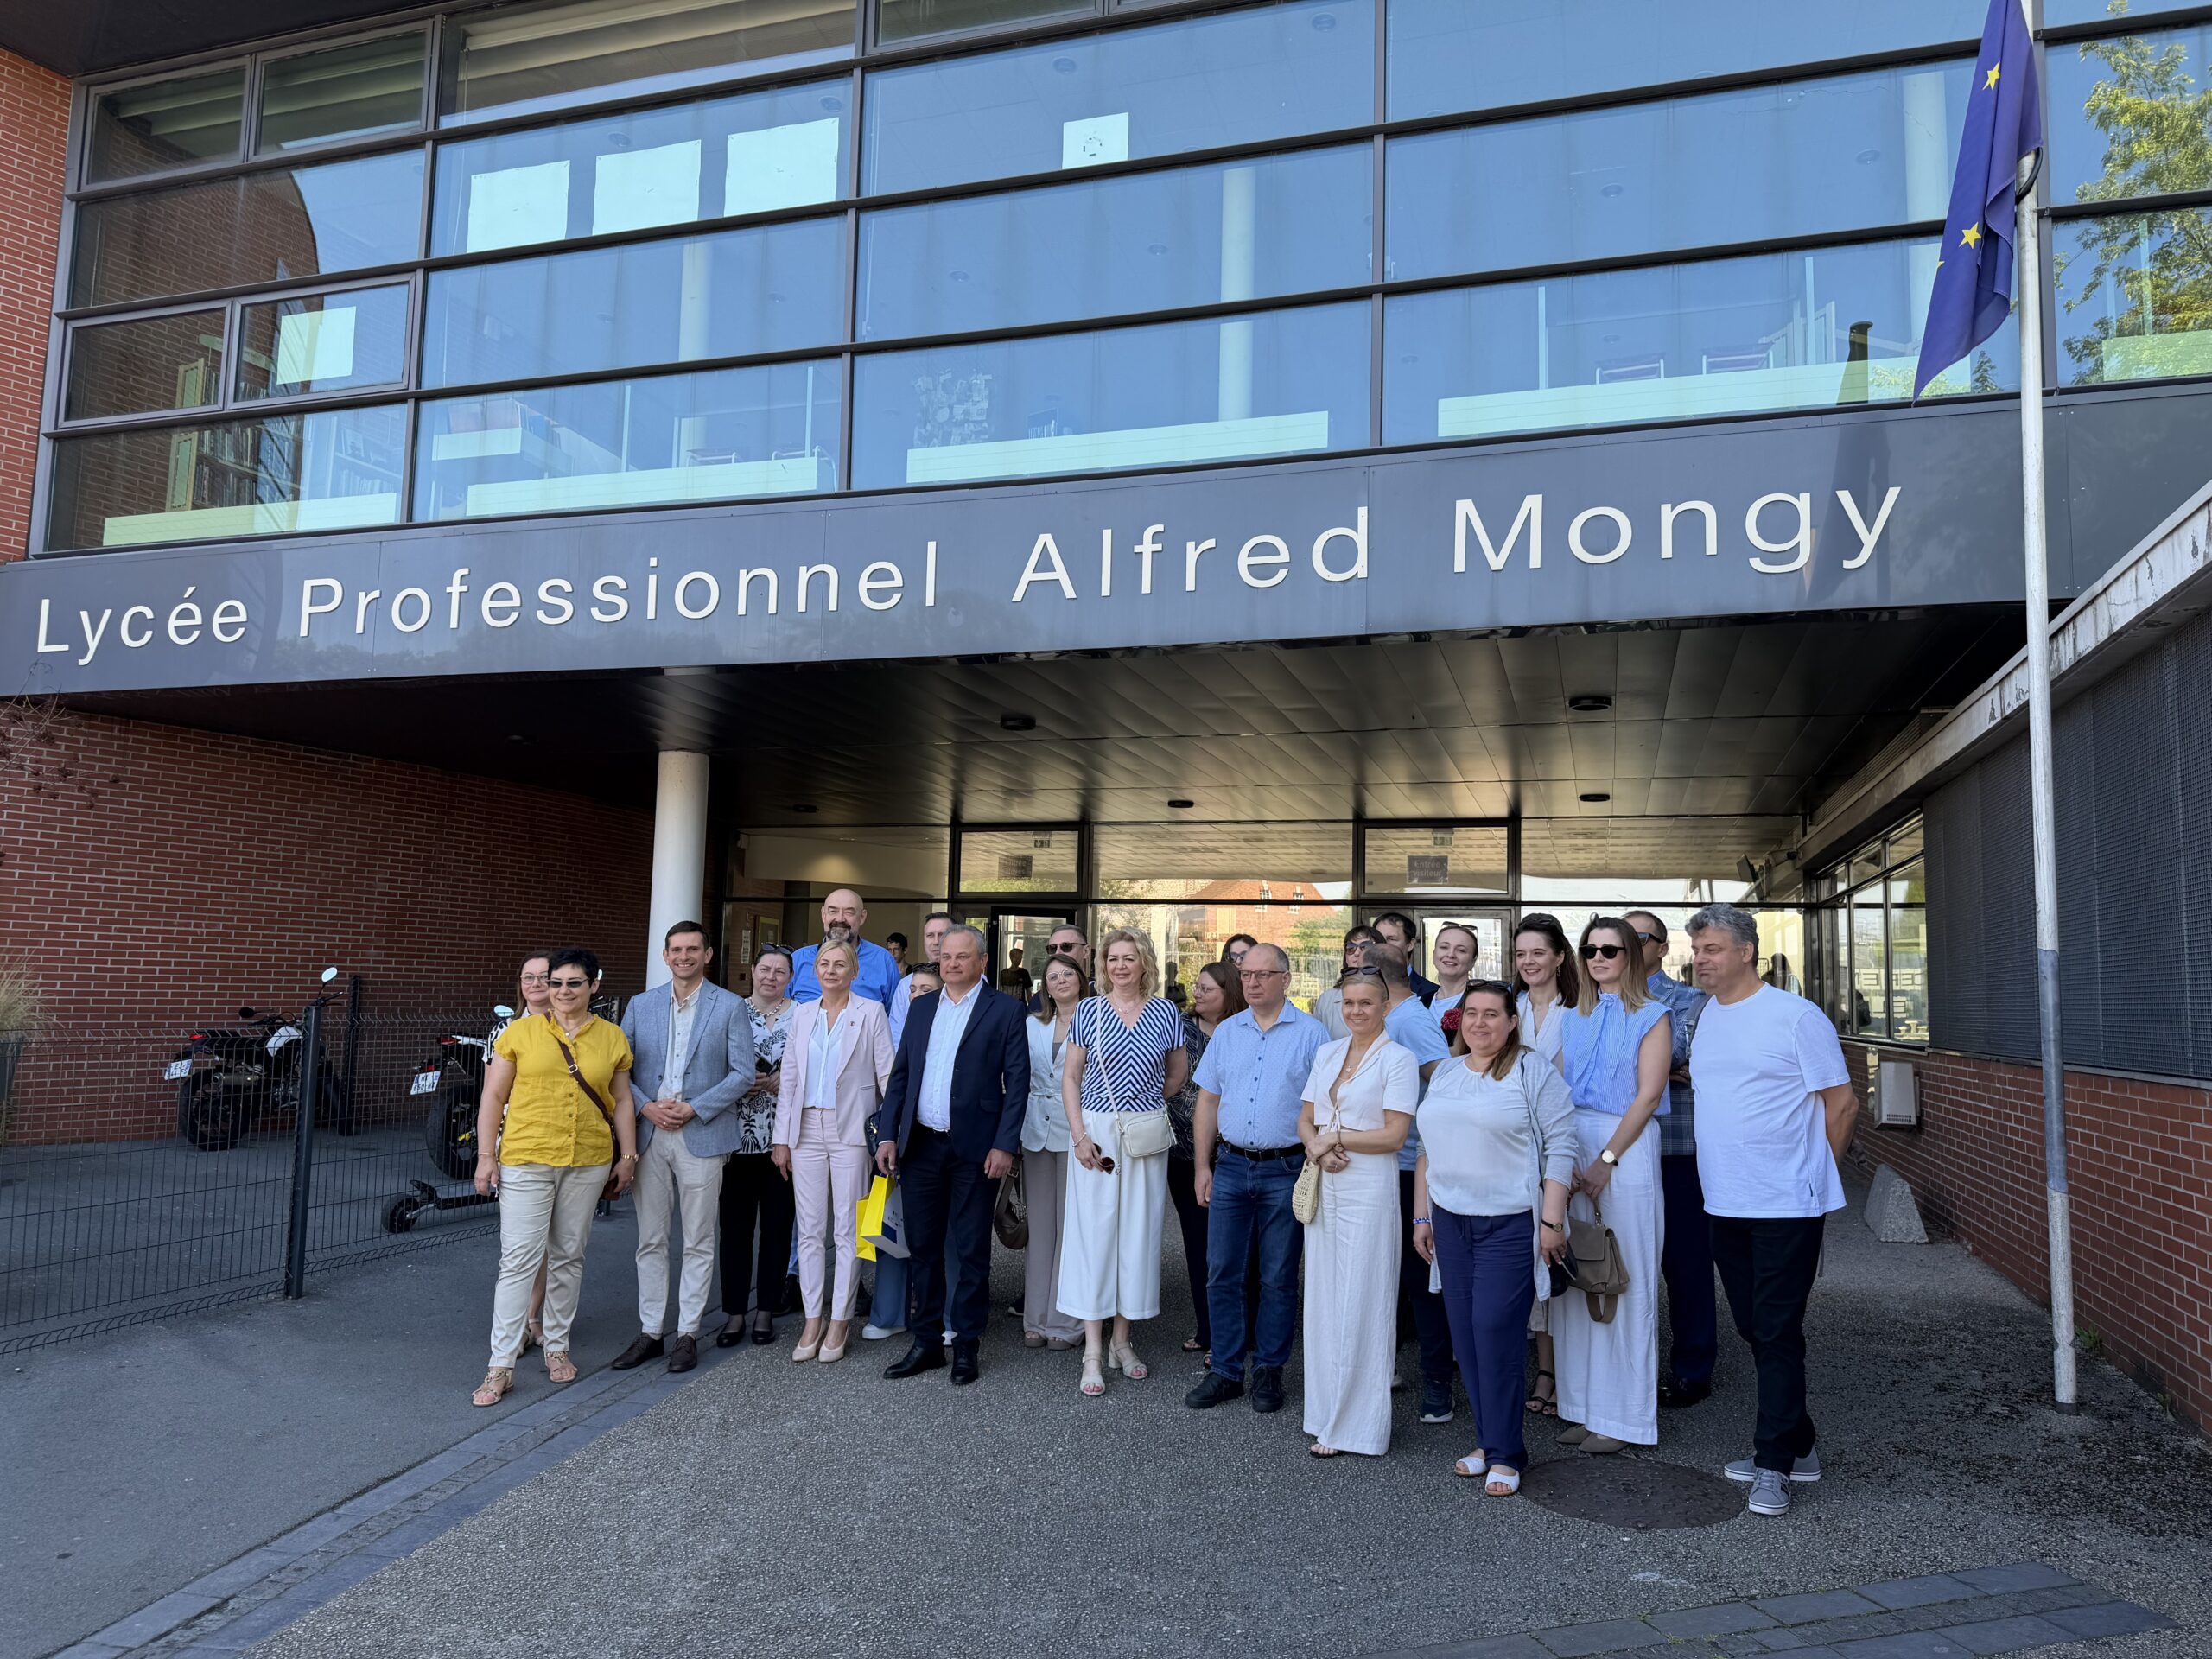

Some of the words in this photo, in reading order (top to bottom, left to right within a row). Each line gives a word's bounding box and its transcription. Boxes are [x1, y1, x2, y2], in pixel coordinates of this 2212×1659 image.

[37, 586, 248, 666] Lycée
[298, 540, 938, 638] Professionnel
[1011, 505, 1370, 603] Alfred
[1452, 486, 1903, 575] Mongy
